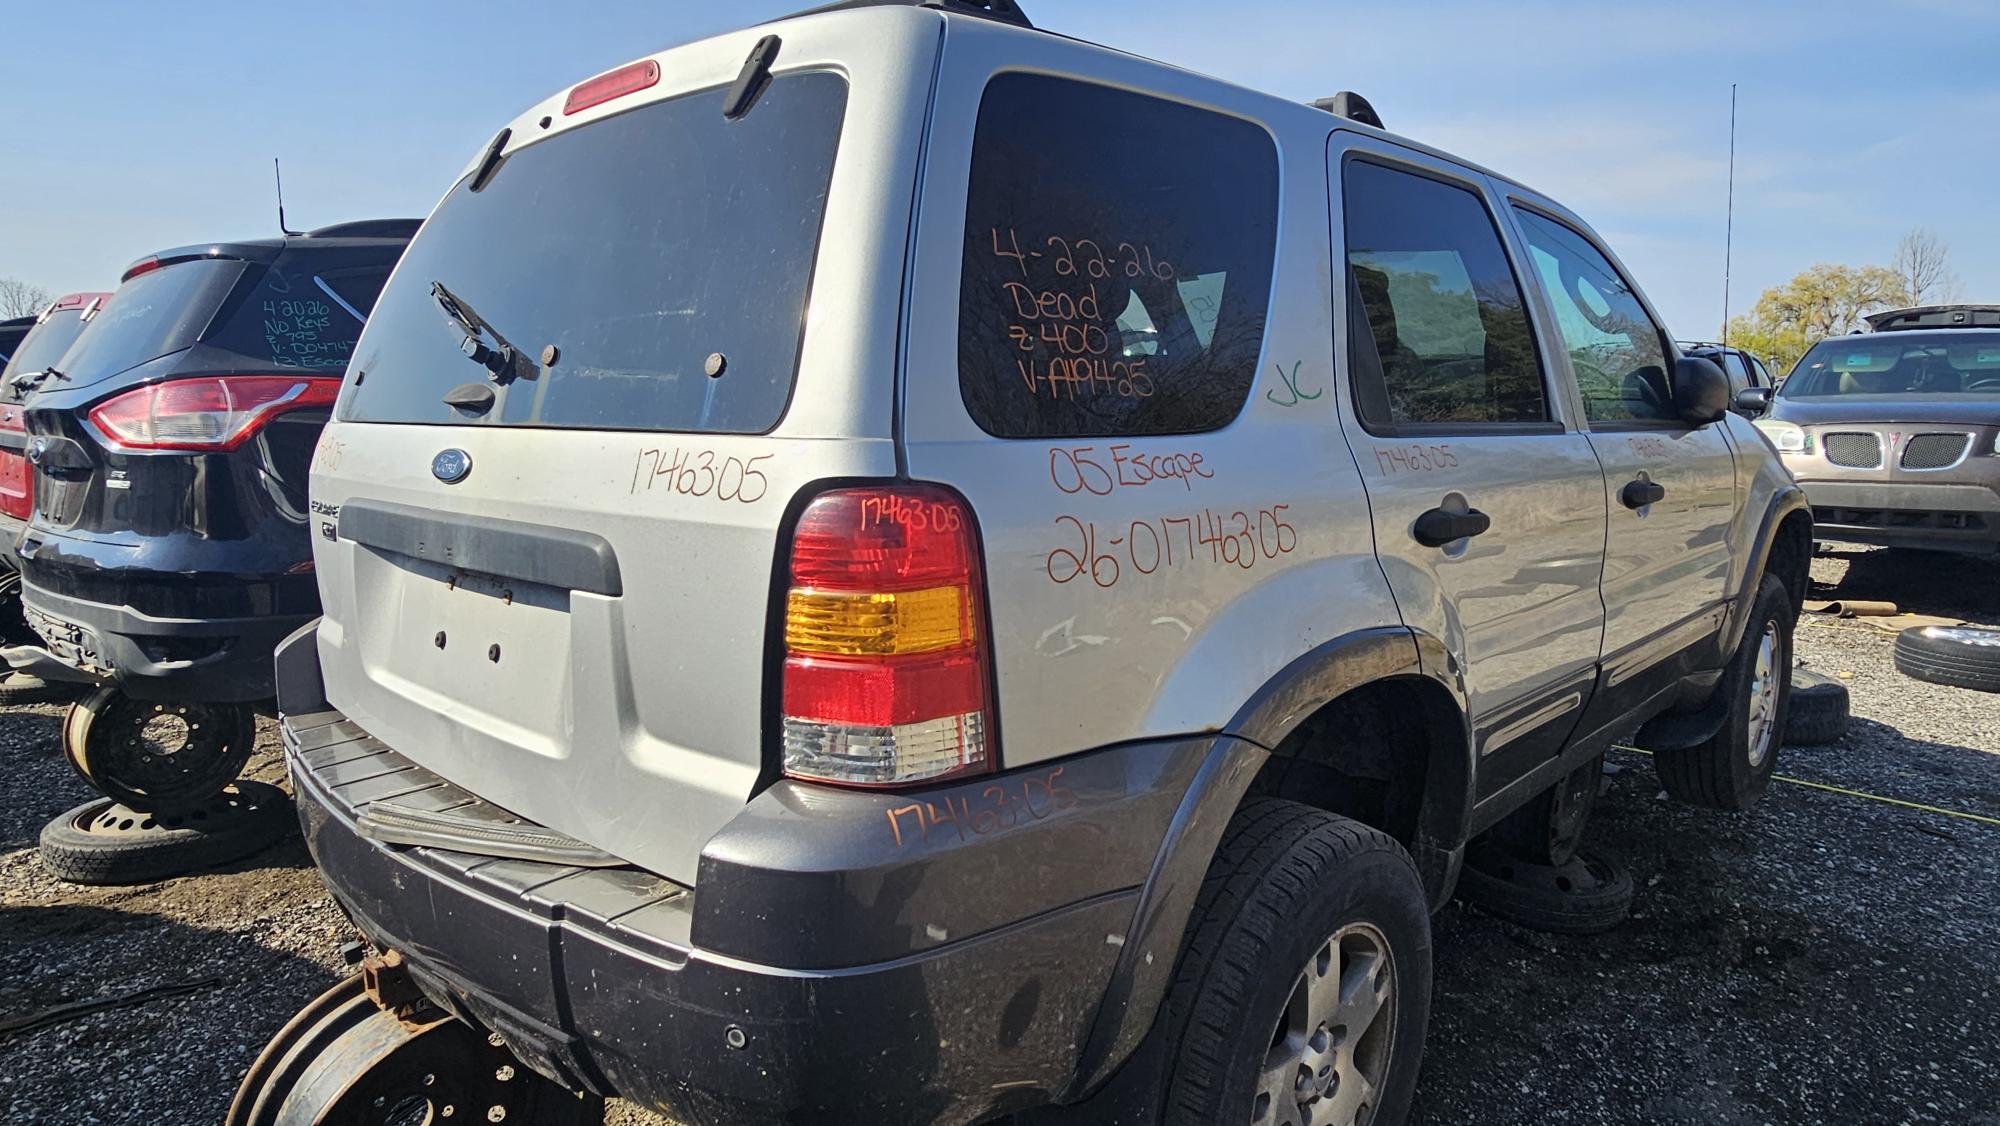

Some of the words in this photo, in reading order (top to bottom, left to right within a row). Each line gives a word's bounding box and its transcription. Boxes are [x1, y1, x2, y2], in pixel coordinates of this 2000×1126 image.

[1002, 282, 1102, 321] Dead
[264, 318, 290, 335] No
[295, 315, 330, 332] Keys
[285, 331, 317, 341] 795
[1041, 323, 1109, 354] 400
[271, 355, 298, 368] 13
[1266, 360, 1323, 408] JC
[1110, 445, 1214, 491] Escape
